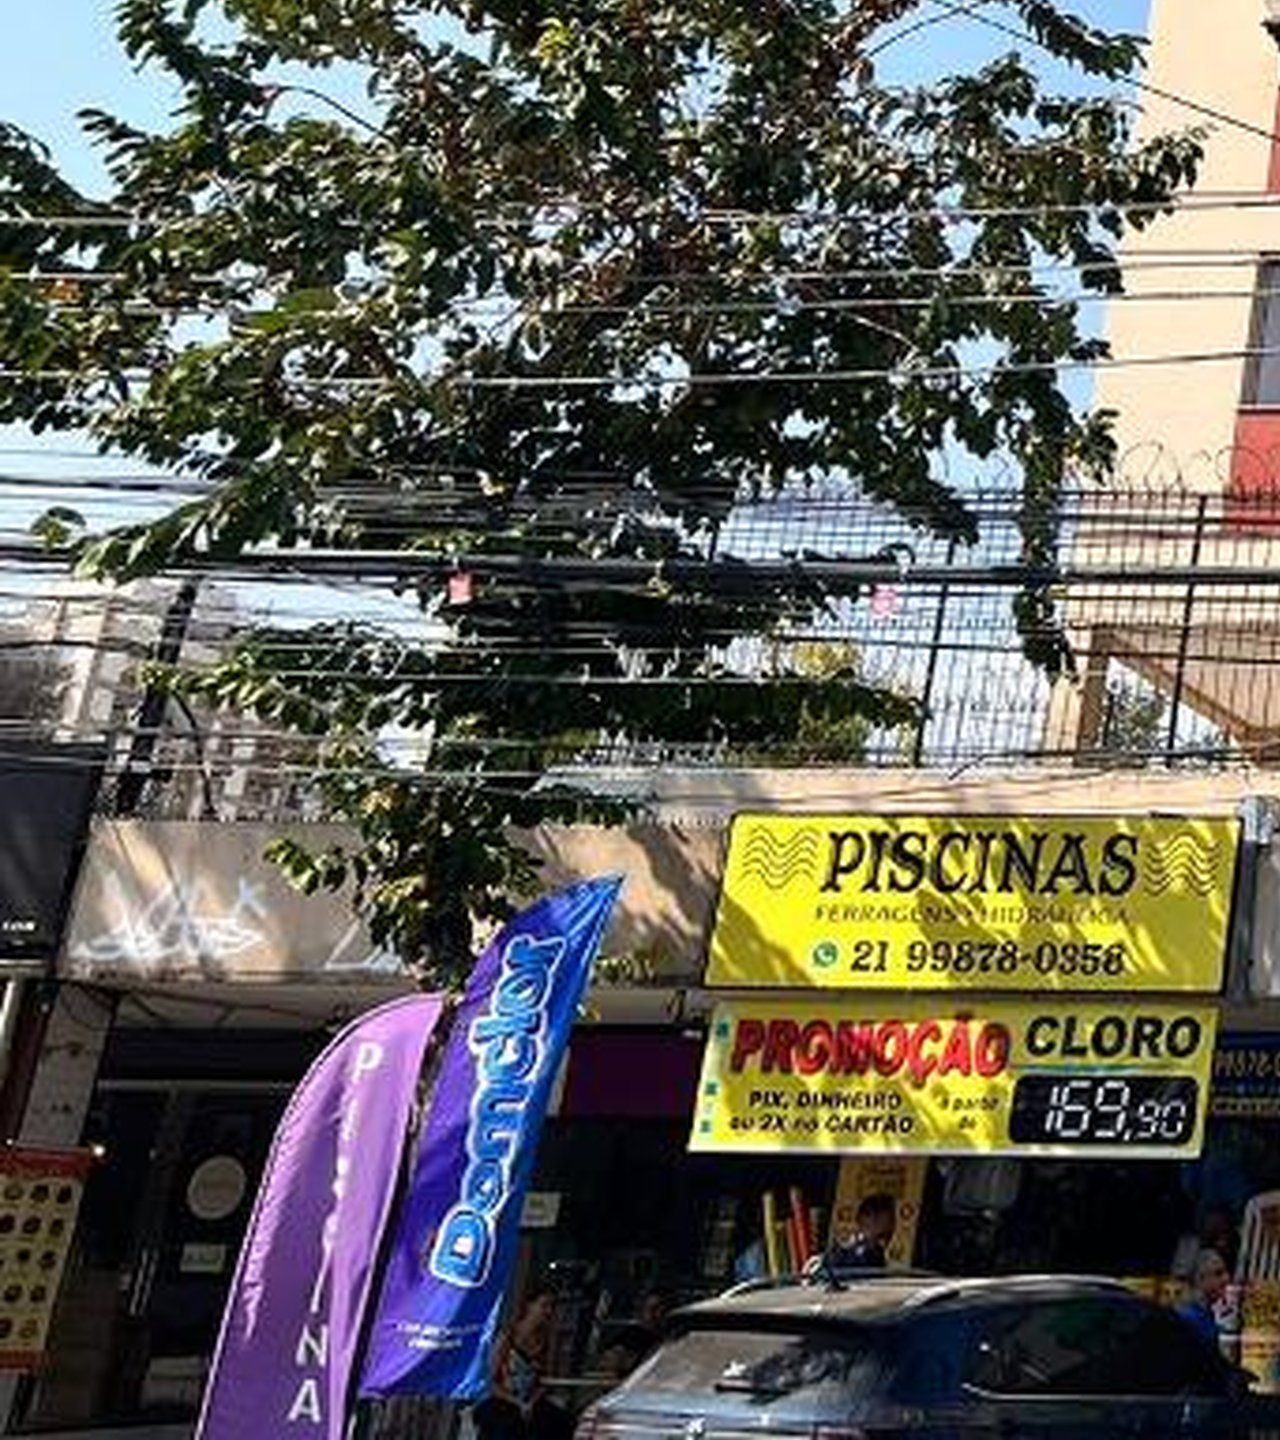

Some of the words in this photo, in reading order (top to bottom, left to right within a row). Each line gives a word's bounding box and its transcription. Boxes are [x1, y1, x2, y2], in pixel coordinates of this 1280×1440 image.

[818, 830, 1139, 896] PISCINAS
[814, 905, 957, 924] FERRAGENS
[850, 940, 890, 973] 21
[730, 1012, 1011, 1090] PROMOÇÃO
[1026, 1015, 1201, 1058] CLORO
[750, 1090, 788, 1110] PIX,
[796, 1090, 902, 1110] DINHEIRO
[1044, 1080, 1187, 1142] 169,90
[760, 1113, 789, 1132] 2X
[824, 1112, 914, 1134] CARTÃO
